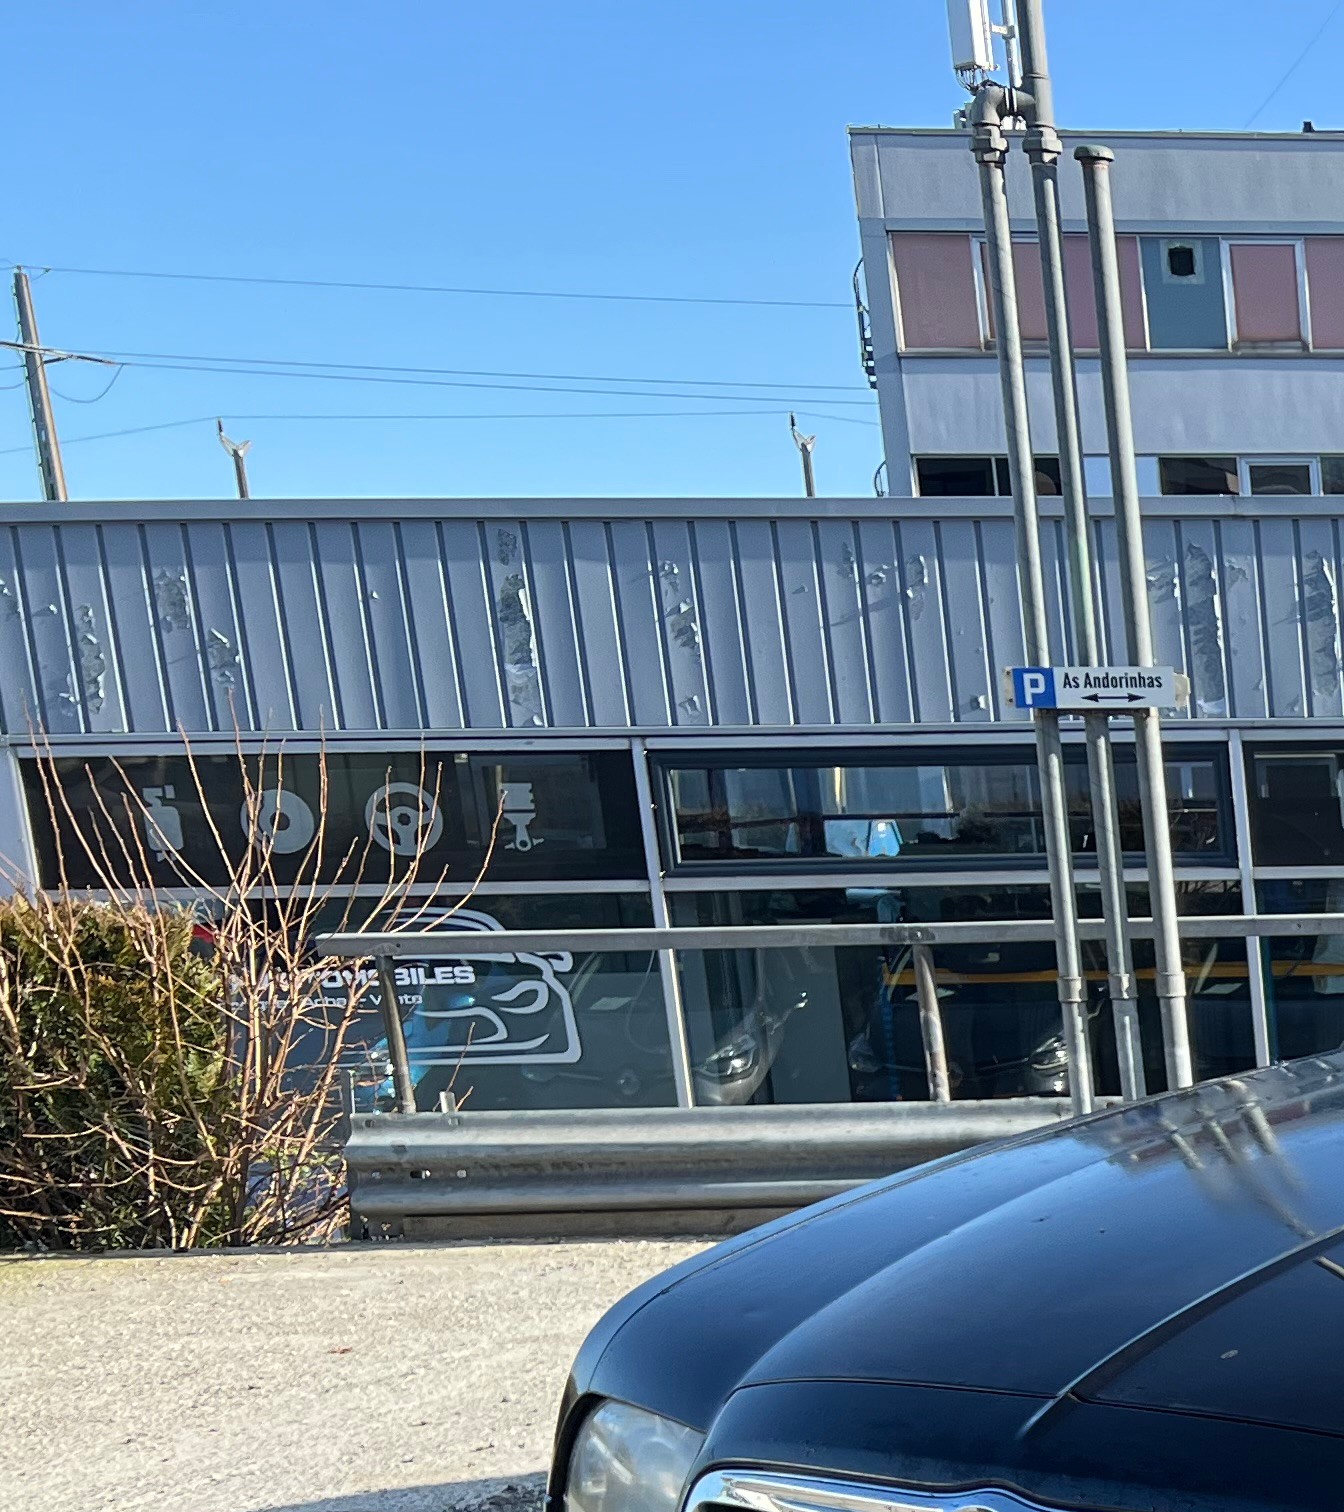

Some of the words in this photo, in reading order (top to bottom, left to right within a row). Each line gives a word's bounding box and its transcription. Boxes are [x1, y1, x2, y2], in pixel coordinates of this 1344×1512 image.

[1023, 673, 1046, 705] P
[1063, 672, 1080, 689] As
[1084, 671, 1163, 689] Andorinhas
